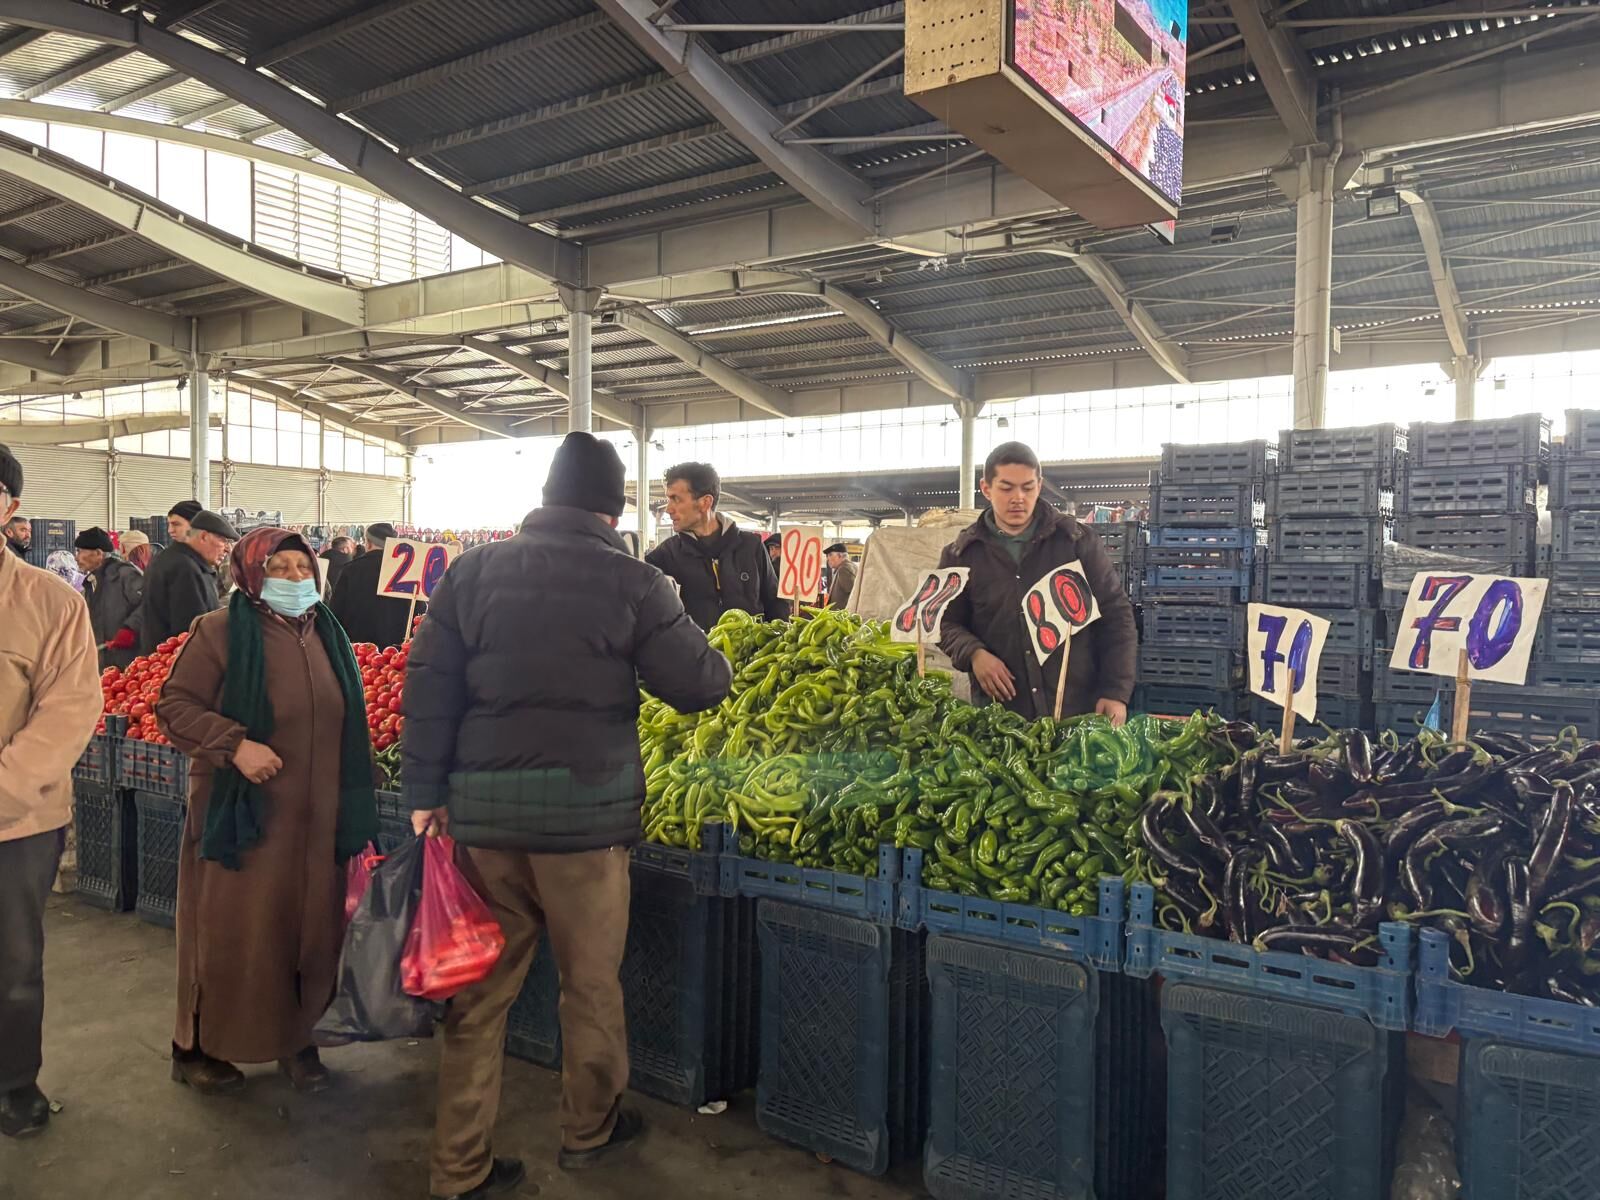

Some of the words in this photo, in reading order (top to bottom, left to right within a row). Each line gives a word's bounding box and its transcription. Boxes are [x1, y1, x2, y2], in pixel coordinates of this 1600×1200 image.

[383, 542, 449, 598] 20
[781, 528, 821, 596] 80
[1026, 568, 1093, 655] 80
[1408, 575, 1524, 670] 70
[1257, 612, 1313, 695] 70
